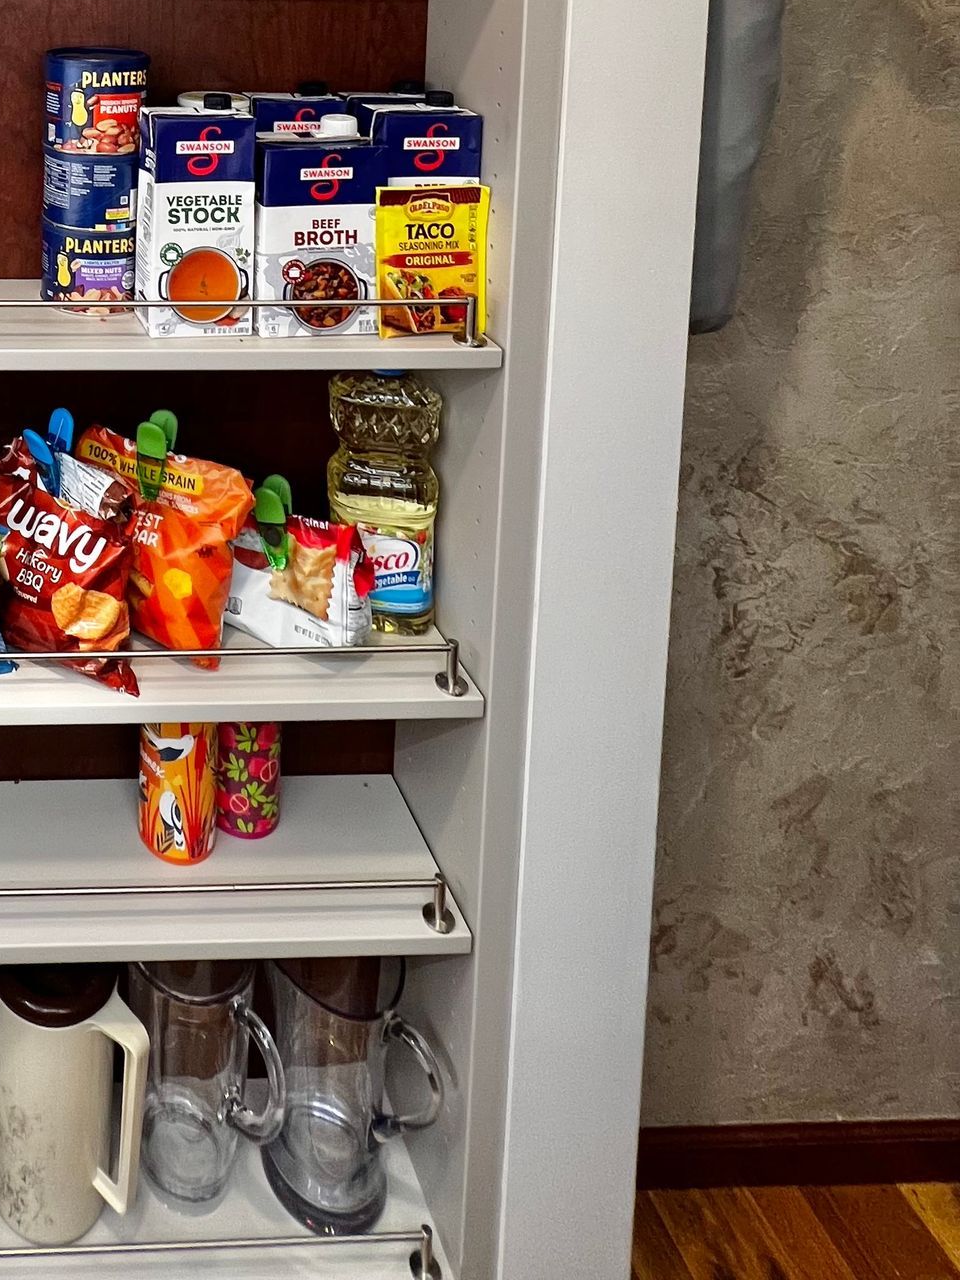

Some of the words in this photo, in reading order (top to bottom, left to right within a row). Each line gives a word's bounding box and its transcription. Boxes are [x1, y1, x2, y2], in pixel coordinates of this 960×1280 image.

[81, 69, 147, 89] PLANTERS
[100, 104, 138, 114] PEANUTS
[277, 123, 321, 131] SWANSO
[179, 142, 232, 152] SWANSON
[406, 139, 456, 148] SWANSON
[303, 169, 350, 178] SWANSON
[166, 195, 243, 207] VEGETABLE
[167, 207, 241, 224] STOCK
[312, 218, 341, 229] BEEF
[404, 222, 455, 240] TACO
[294, 229, 358, 246] BROTH
[65, 236, 135, 254] PLANTERS
[399, 241, 444, 252] SEASONING
[445, 239, 460, 249] MIX
[405, 254, 456, 266] ORIGINAL
[80, 266, 104, 274] MIXED
[104, 266, 122, 274] NUTS
[88, 442, 118, 467] 100%
[160, 471, 197, 491] GRAIN
[6, 497, 107, 574] wavy
[16, 567, 44, 593] BBQ
